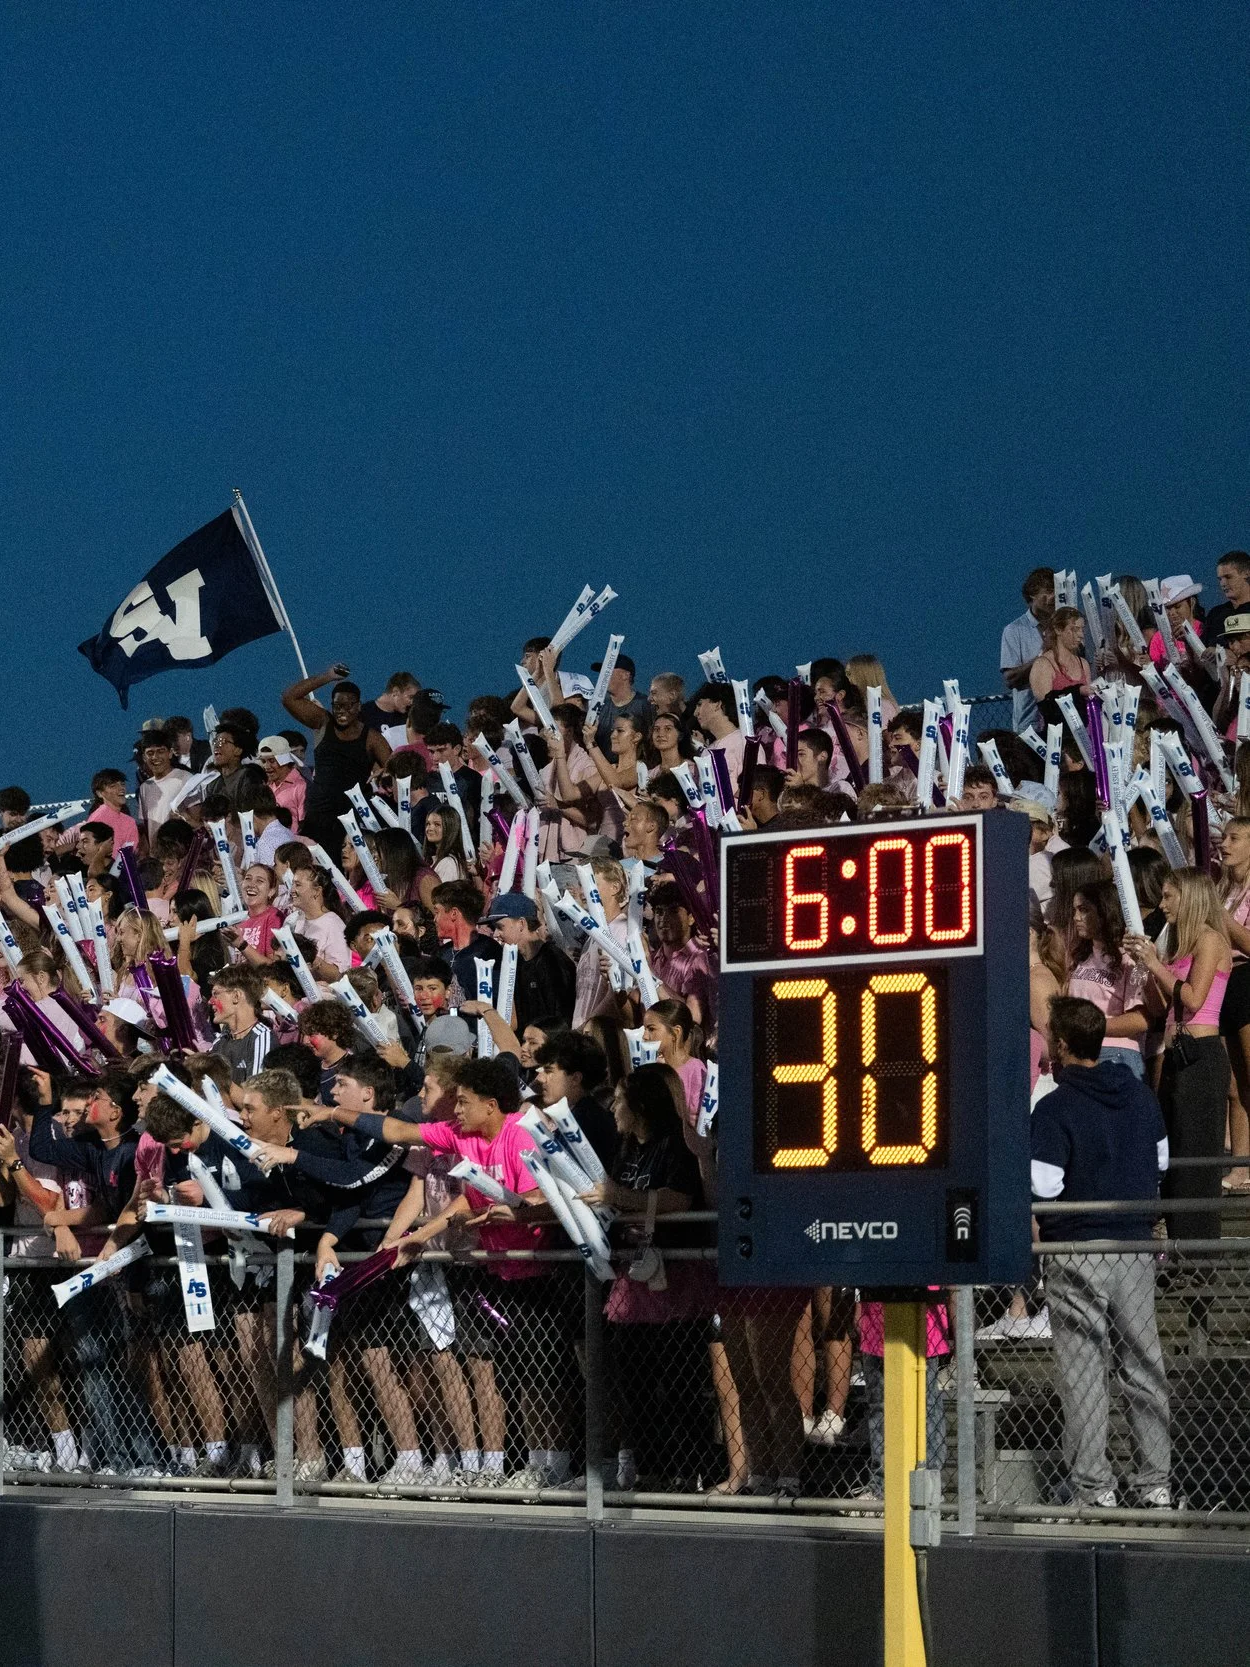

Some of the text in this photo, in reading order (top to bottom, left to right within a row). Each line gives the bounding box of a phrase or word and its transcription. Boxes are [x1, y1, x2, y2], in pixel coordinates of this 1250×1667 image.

[1151, 806, 1168, 822] SV
[785, 833, 970, 950] 6:00
[581, 916, 600, 931] SV
[479, 981, 492, 998] SV
[772, 973, 937, 1167] 30
[564, 1128, 583, 1144] SV
[542, 1139, 563, 1154] SV
[821, 1221, 898, 1241] NEVCO
[187, 1278, 207, 1298] SV
